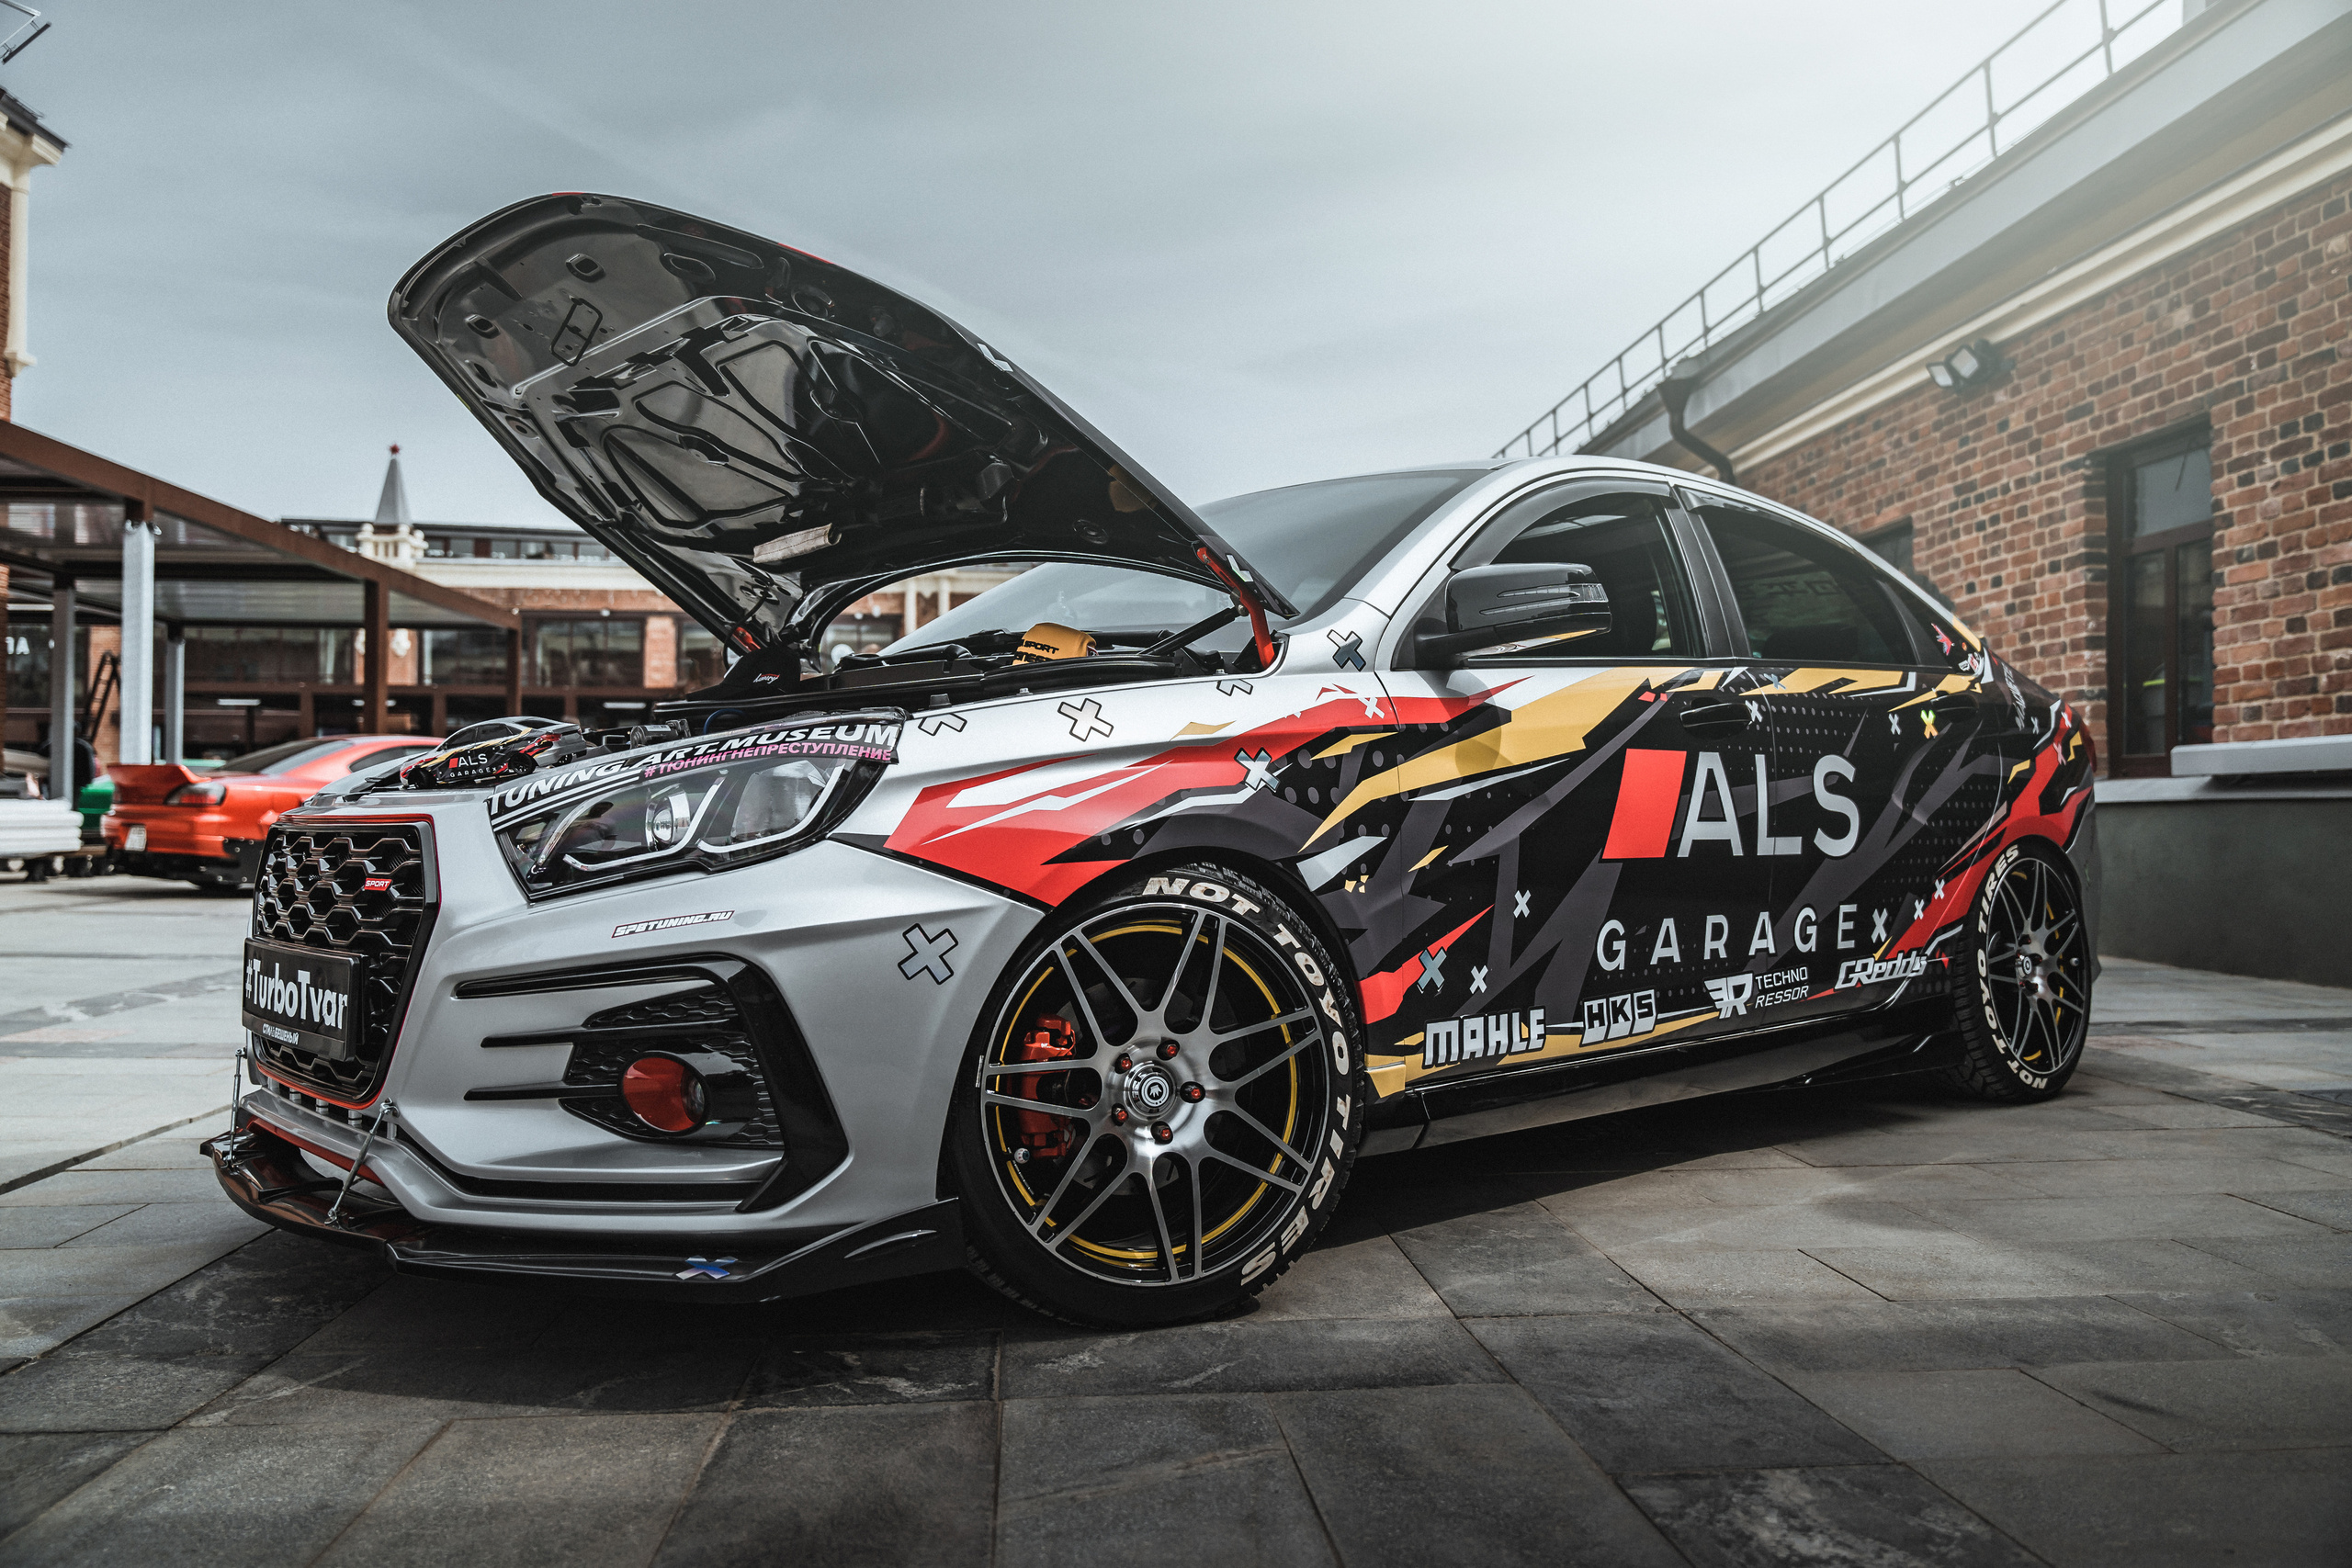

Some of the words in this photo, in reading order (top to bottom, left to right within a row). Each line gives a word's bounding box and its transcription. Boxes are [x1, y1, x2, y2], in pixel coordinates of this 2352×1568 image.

[449, 767, 491, 778] GARAGE
[458, 753, 488, 768] ALS
[644, 741, 891, 779] #ТЮНИНГНЕПРЕСТУПЛЕНИЕ
[1677, 751, 1860, 857] ALS
[1142, 876, 1261, 916] NOT
[1978, 843, 2019, 934] TIRES
[614, 911, 733, 937] SPBTUNING.RU
[1597, 904, 1858, 971] GARAGE
[245, 958, 348, 1030] #TurboTvar
[1273, 922, 1350, 1076] TOYO
[1755, 966, 1808, 990] TECHNO
[1755, 986, 1809, 1009] RESSOR
[1977, 948, 2007, 1055] TOYO
[1424, 1009, 1545, 1066] MAHLE
[1581, 989, 1656, 1045] HKS
[2007, 1058, 2049, 1089] NOT
[1241, 1093, 1351, 1286] TIRES
